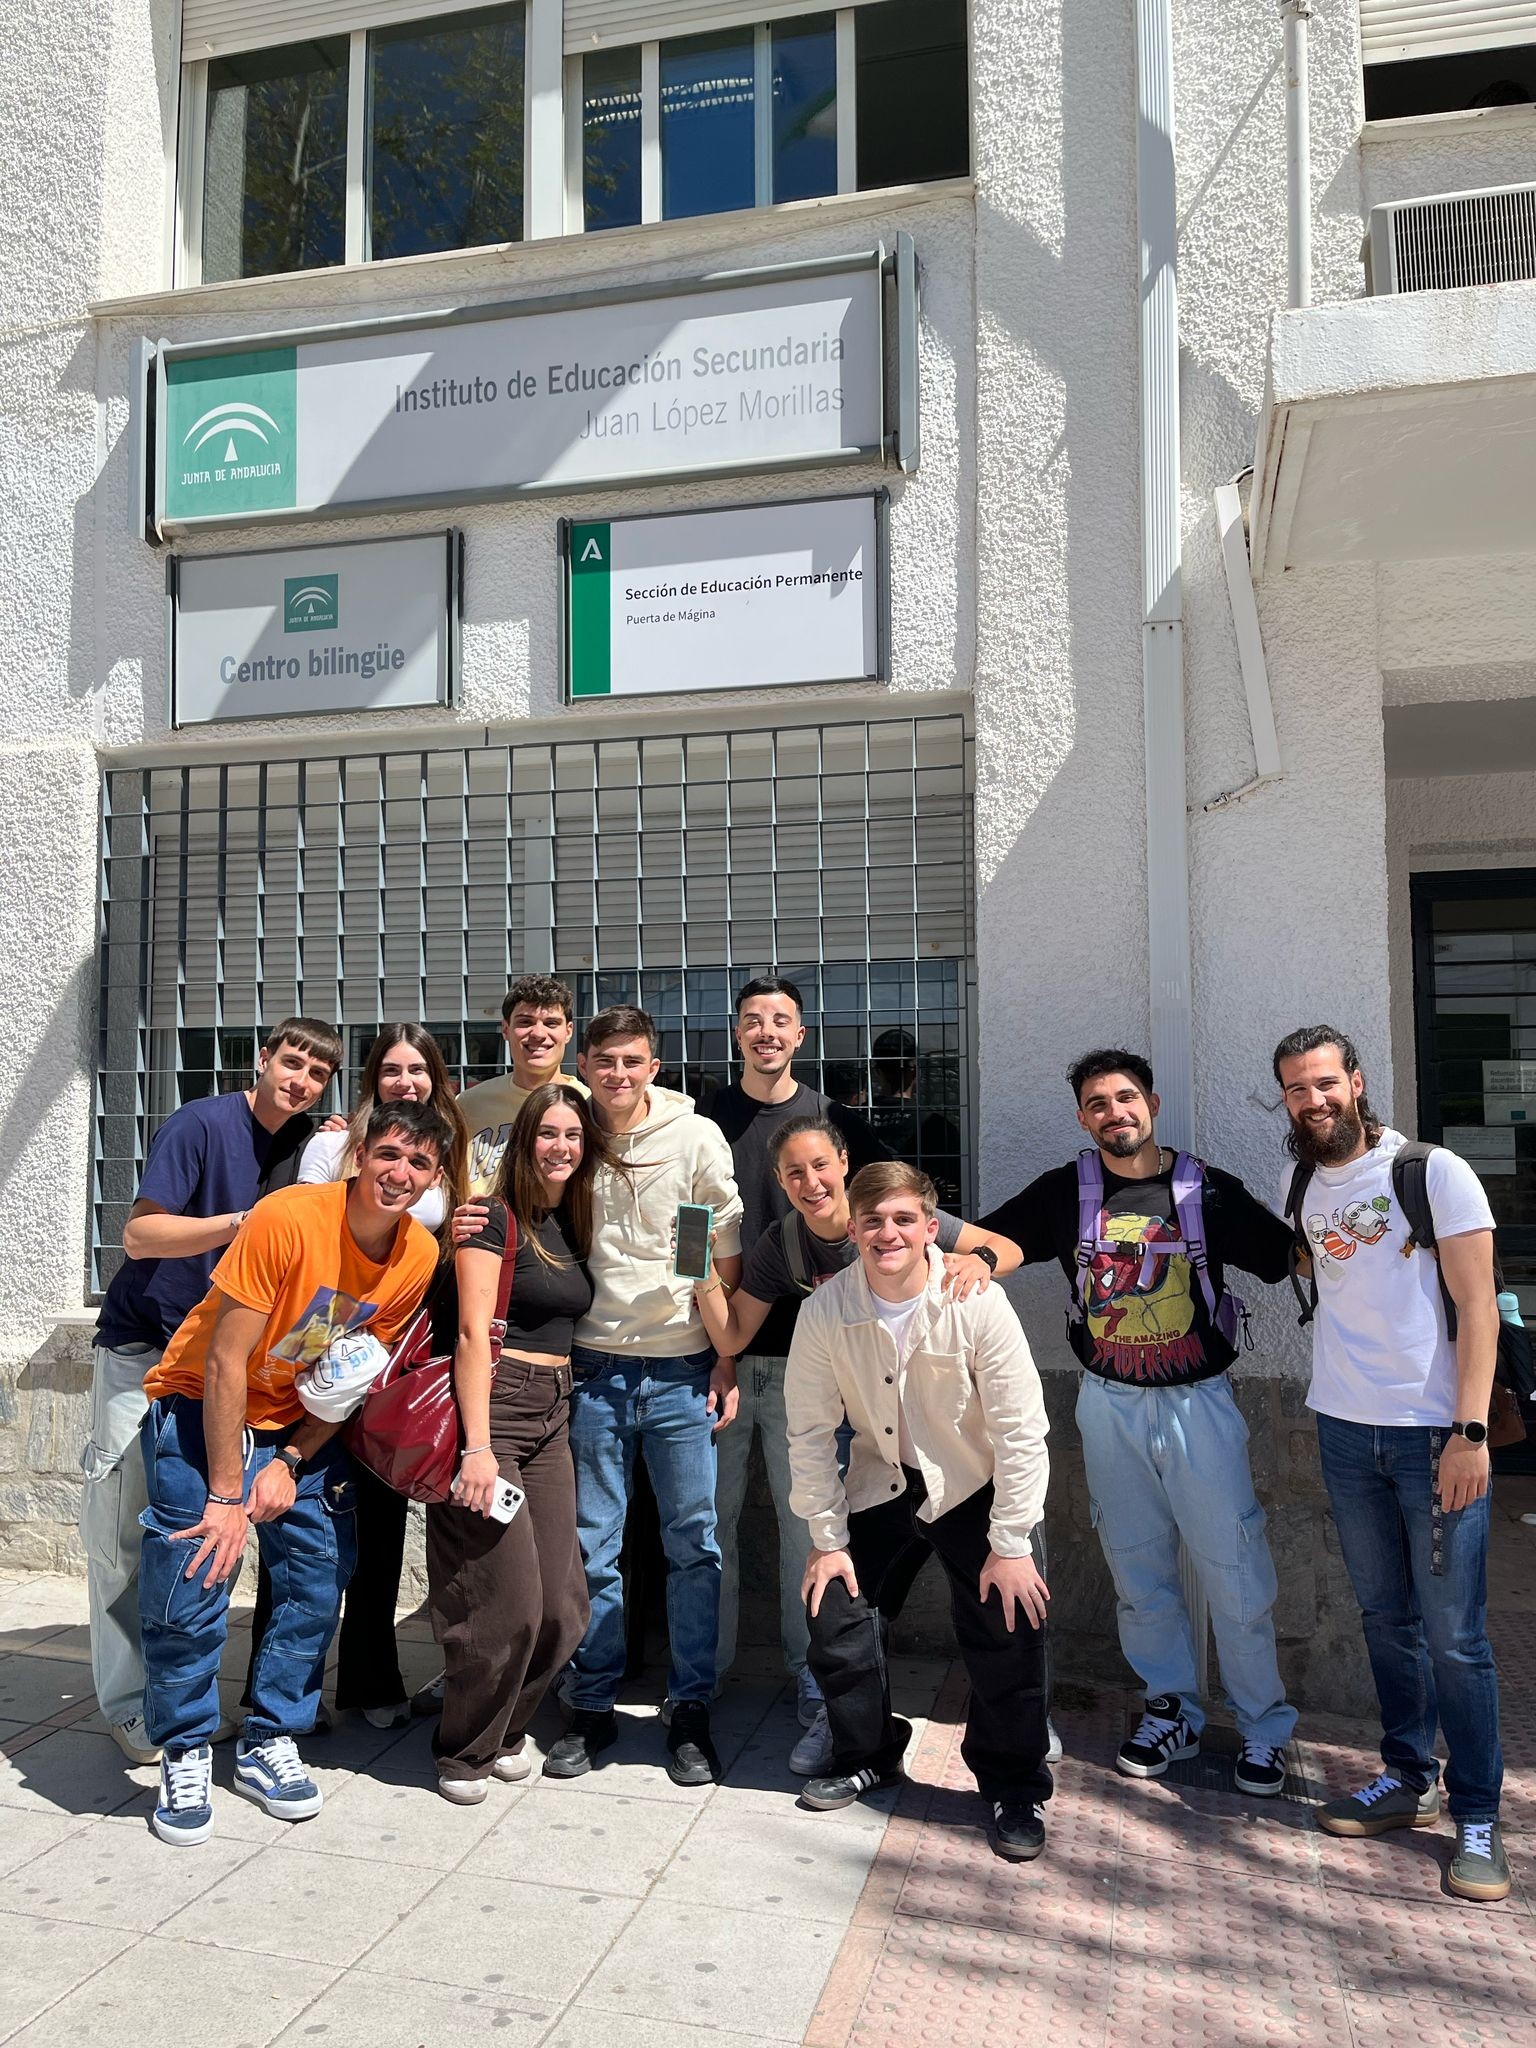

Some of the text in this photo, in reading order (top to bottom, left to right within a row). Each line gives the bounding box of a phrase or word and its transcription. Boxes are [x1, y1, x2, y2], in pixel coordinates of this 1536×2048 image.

[395, 332, 845, 413] Instituto de Educación Secundaria
[579, 383, 845, 440] Juan López Morillas
[181, 462, 281, 485] JUNTA DE ANDALUCIA
[625, 569, 863, 601] Sección de Educación Permanente
[626, 608, 716, 625] Puerta de Mágina
[220, 643, 405, 685] Centro bilingüe
[1113, 1329, 1181, 1344] THE AMAZING
